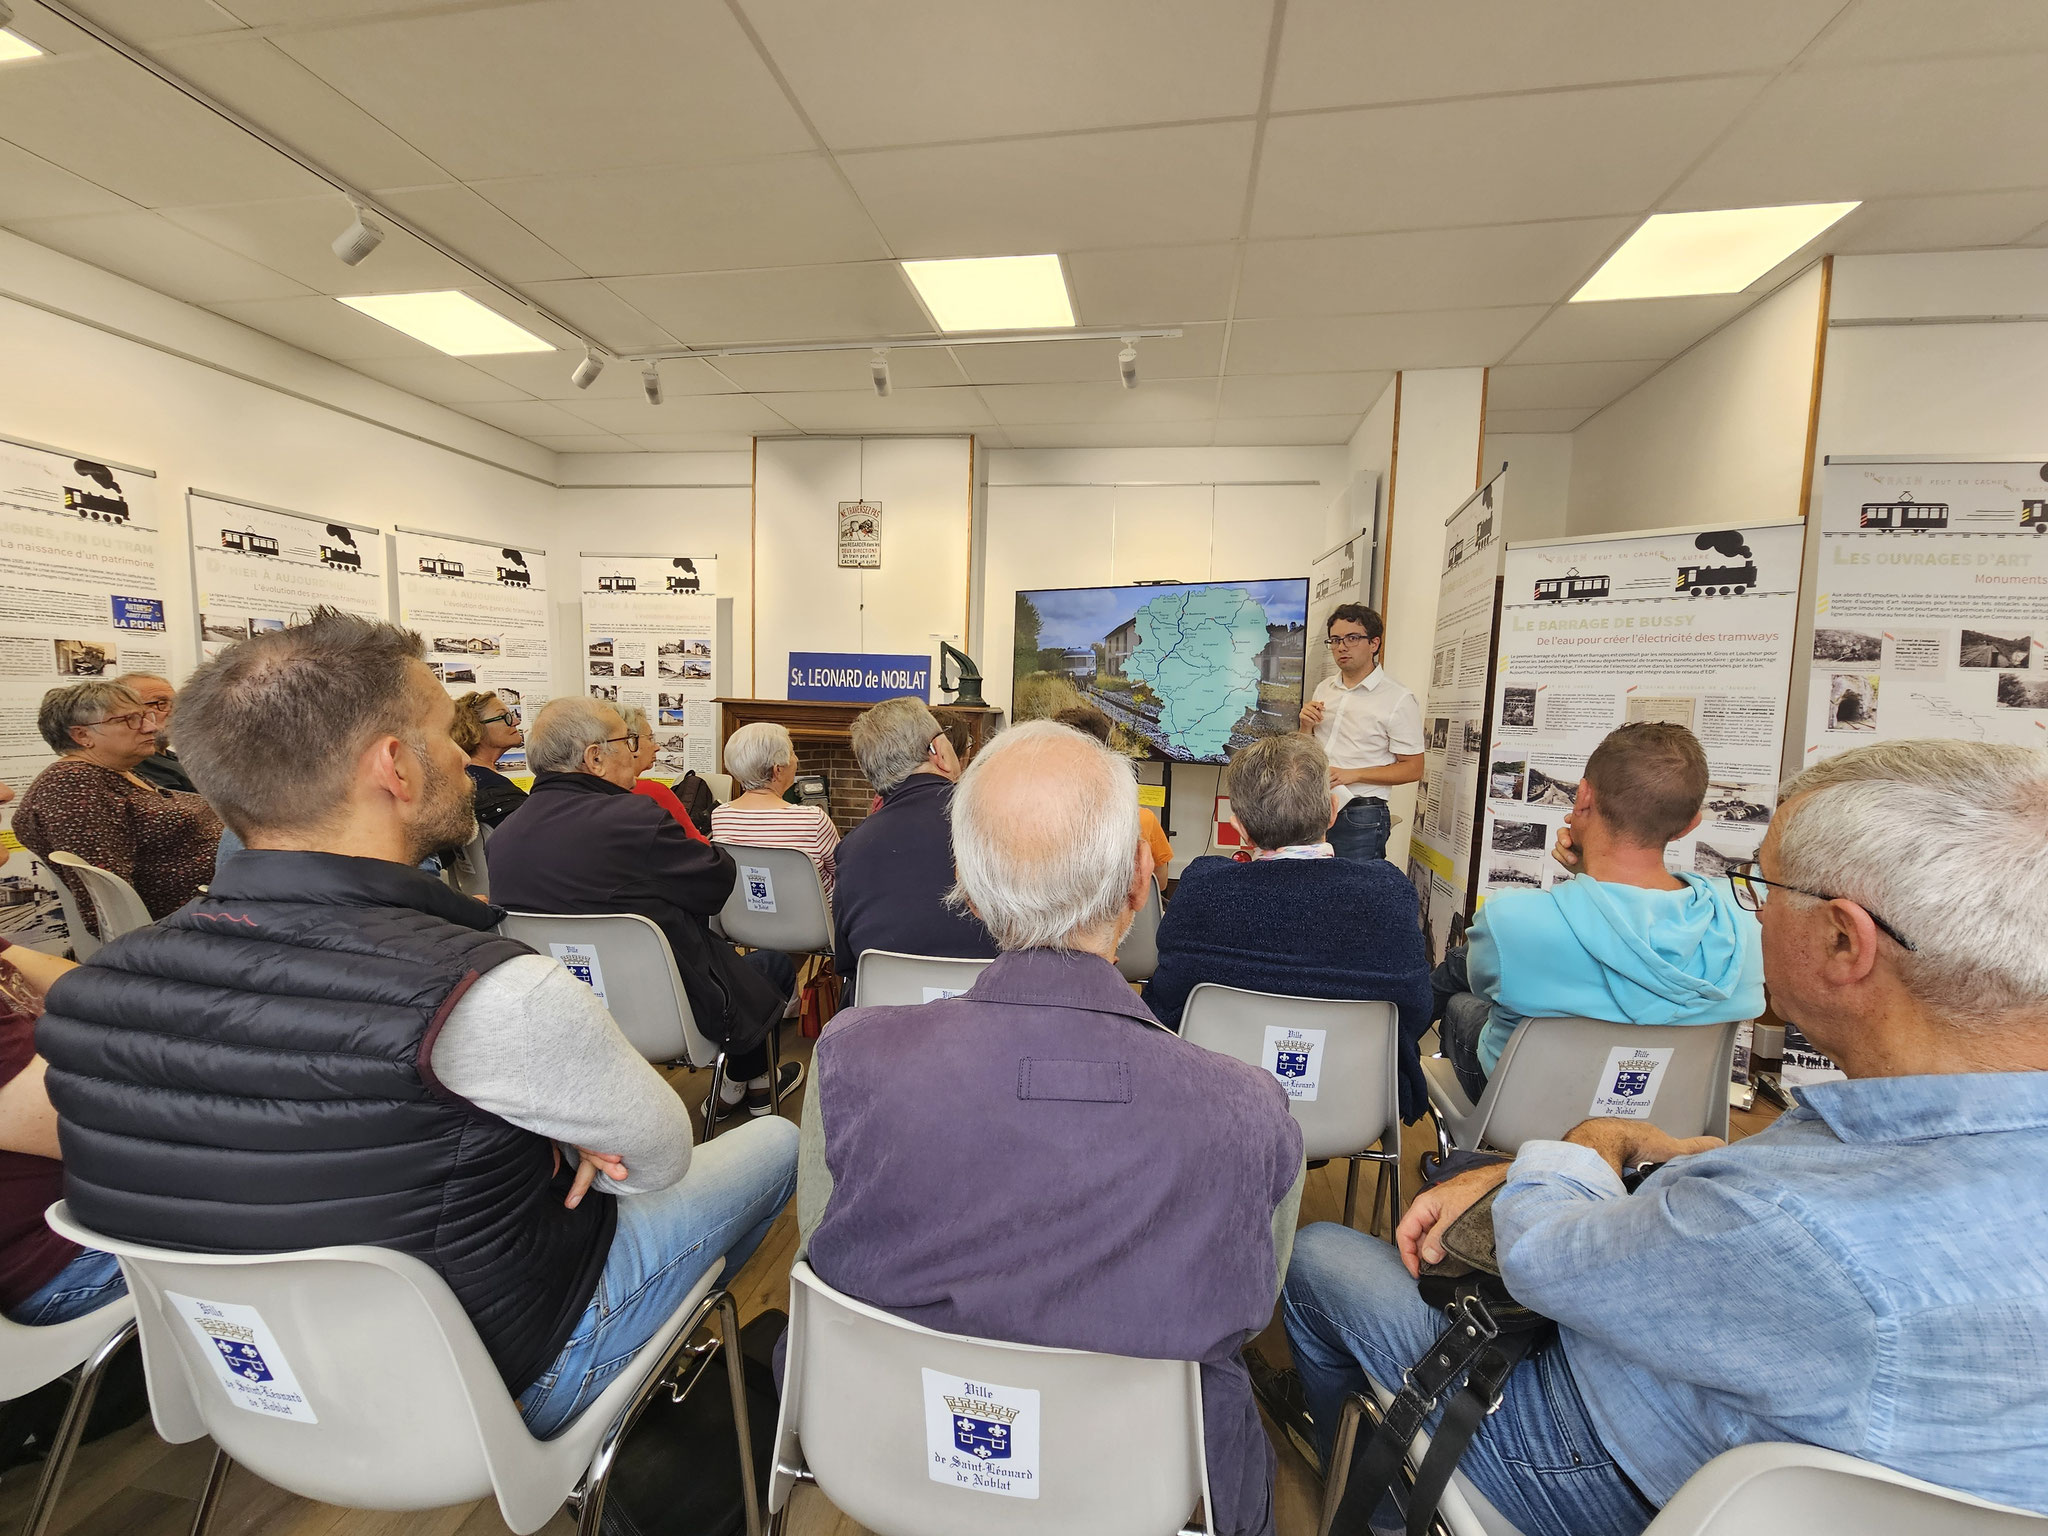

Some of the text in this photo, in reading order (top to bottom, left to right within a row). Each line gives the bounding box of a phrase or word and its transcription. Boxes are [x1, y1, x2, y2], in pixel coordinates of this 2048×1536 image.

[63, 530, 88, 545] FIN
[92, 535, 112, 548] DU
[115, 538, 153, 555] TRAM
[0, 538, 154, 569] La naissance d'un patrimoine
[1877, 552, 1972, 566] OUVRAGES
[1977, 552, 2032, 568] D'ART
[1975, 574, 2048, 585] Monuments
[254, 583, 296, 596] L'évolution
[296, 590, 310, 598] des
[114, 619, 128, 627] LA
[1538, 616, 1609, 631] BARRAGE
[1614, 617, 1634, 629] DE
[1639, 614, 1696, 628] BUSSY
[1537, 631, 1779, 648] De l'eau pour créer l'électricité des tramways
[791, 668, 927, 690] St. LEONARD de NOBLAT
[964, 1382, 993, 1398] Ville
[935, 1452, 1033, 1480] de Saint-Léonard
[957, 1472, 1011, 1490] de Noblat
